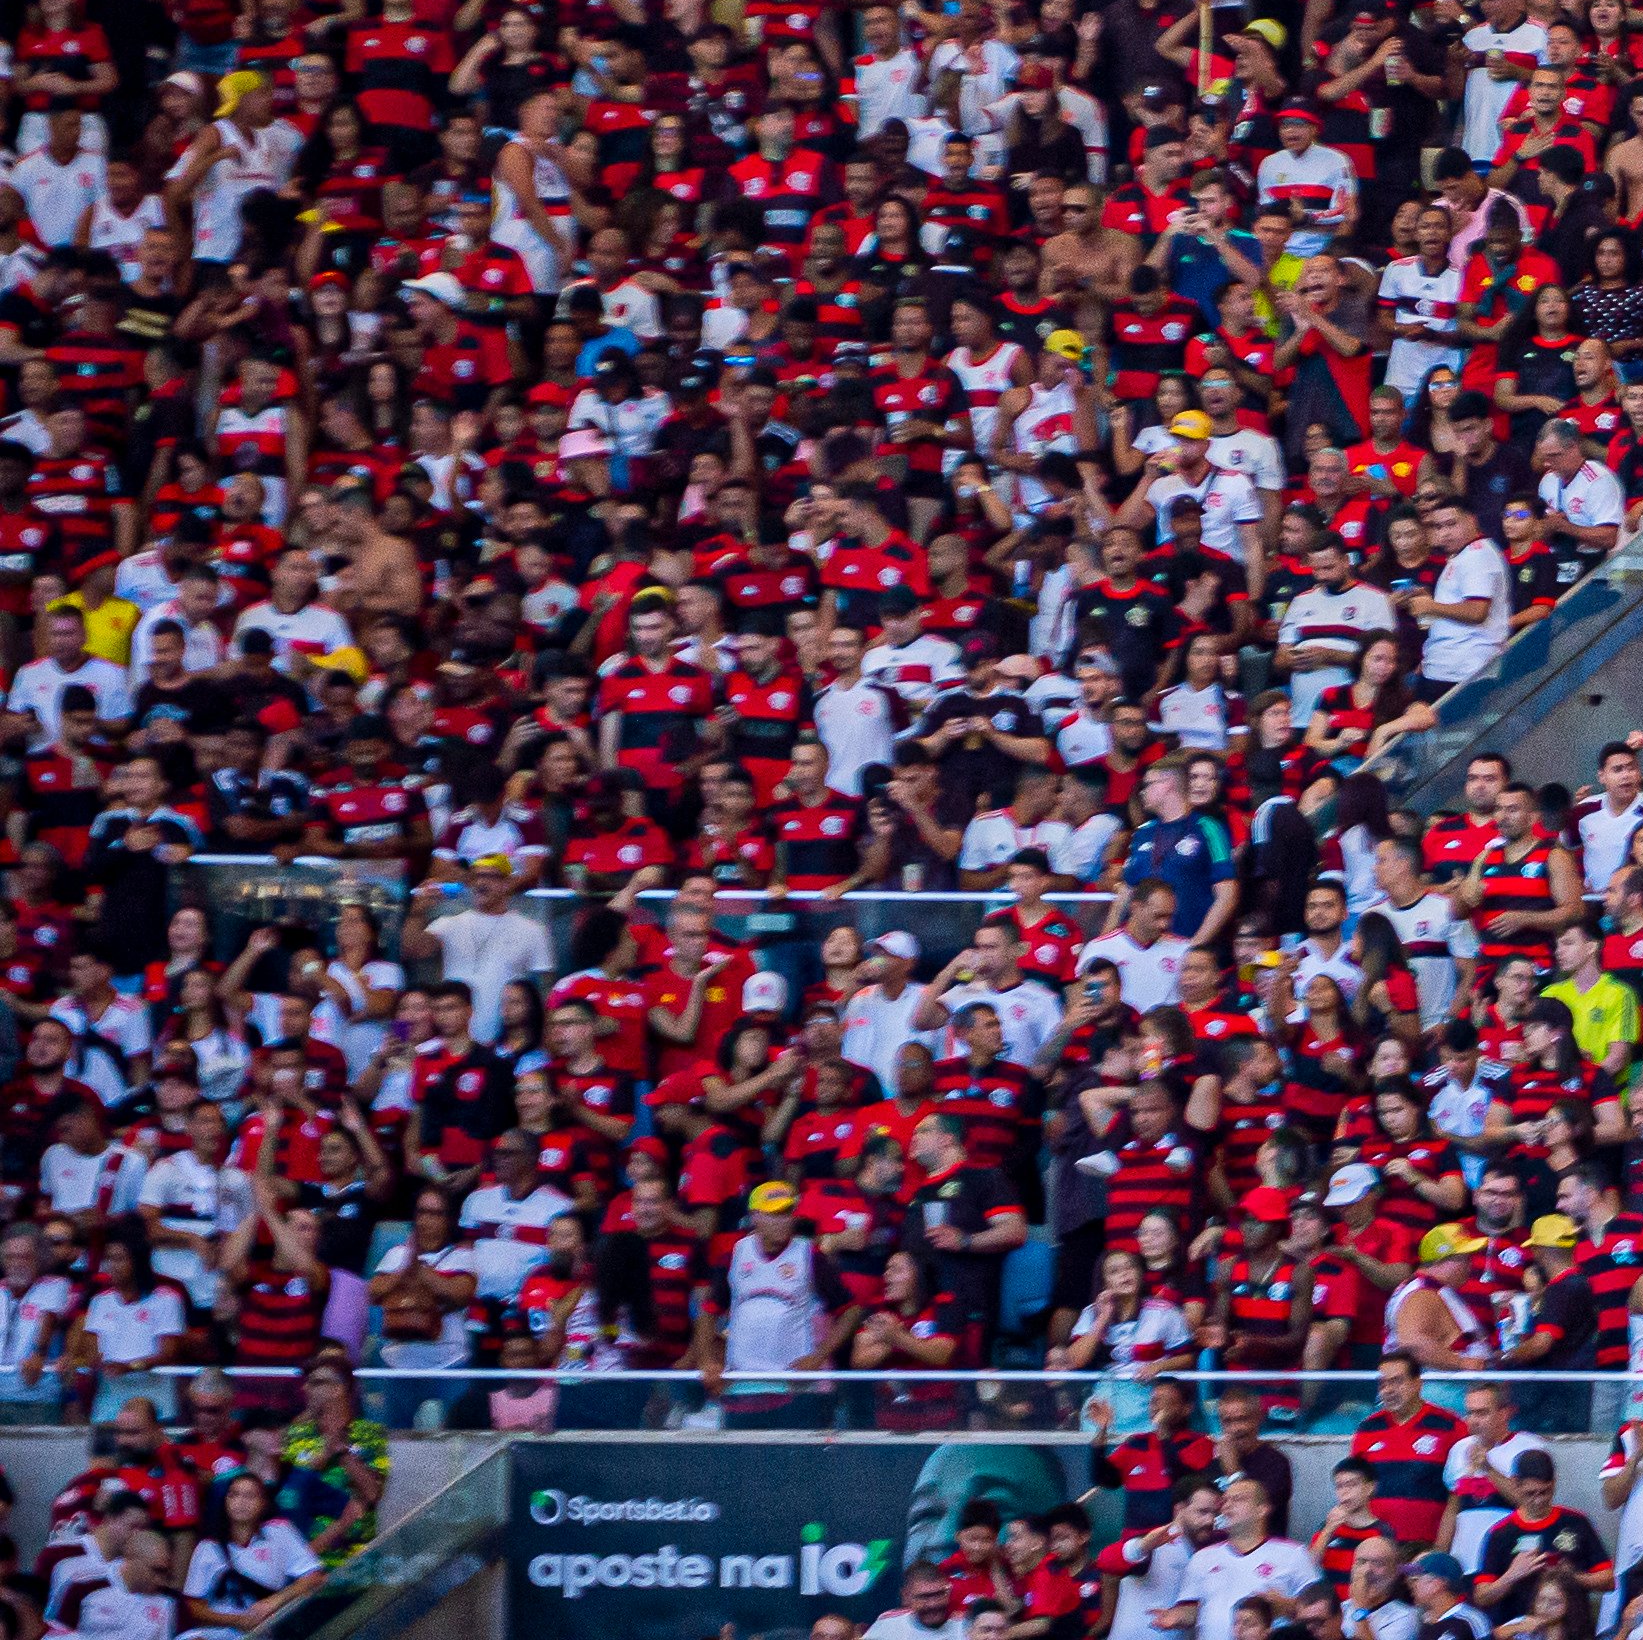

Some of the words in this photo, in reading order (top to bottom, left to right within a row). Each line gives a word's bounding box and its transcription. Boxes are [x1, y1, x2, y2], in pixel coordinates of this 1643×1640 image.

[566, 1496, 718, 1527] Sportsbet.io
[528, 1553, 712, 1598] aposte
[718, 1554, 793, 1589] na
